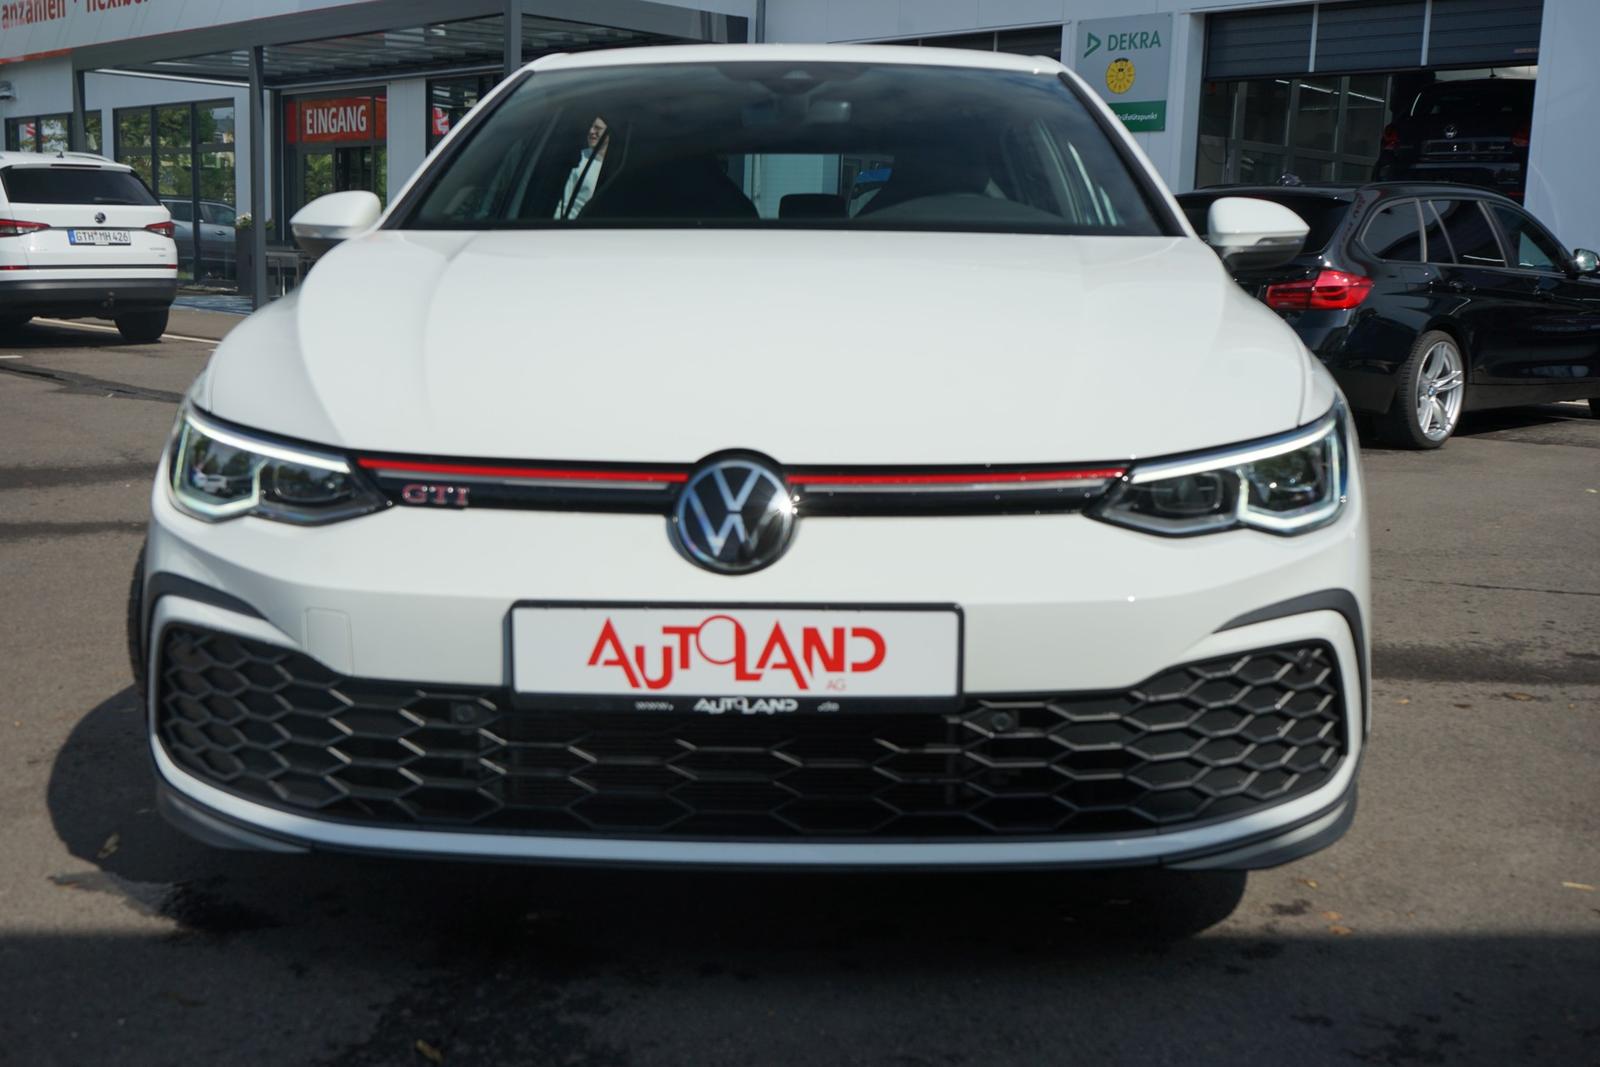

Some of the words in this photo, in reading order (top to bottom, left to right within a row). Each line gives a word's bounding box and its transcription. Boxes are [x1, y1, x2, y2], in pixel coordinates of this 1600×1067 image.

[1107, 30, 1161, 51] DEKRA
[306, 104, 367, 135] EINGANG
[76, 231, 94, 241] GTH
[99, 231, 111, 240] MH
[112, 230, 129, 242] 426
[402, 483, 470, 506] GTI
[587, 614, 887, 690] AUTOLAND
[825, 679, 848, 691] AG
[694, 697, 798, 715] AUTOLAND
